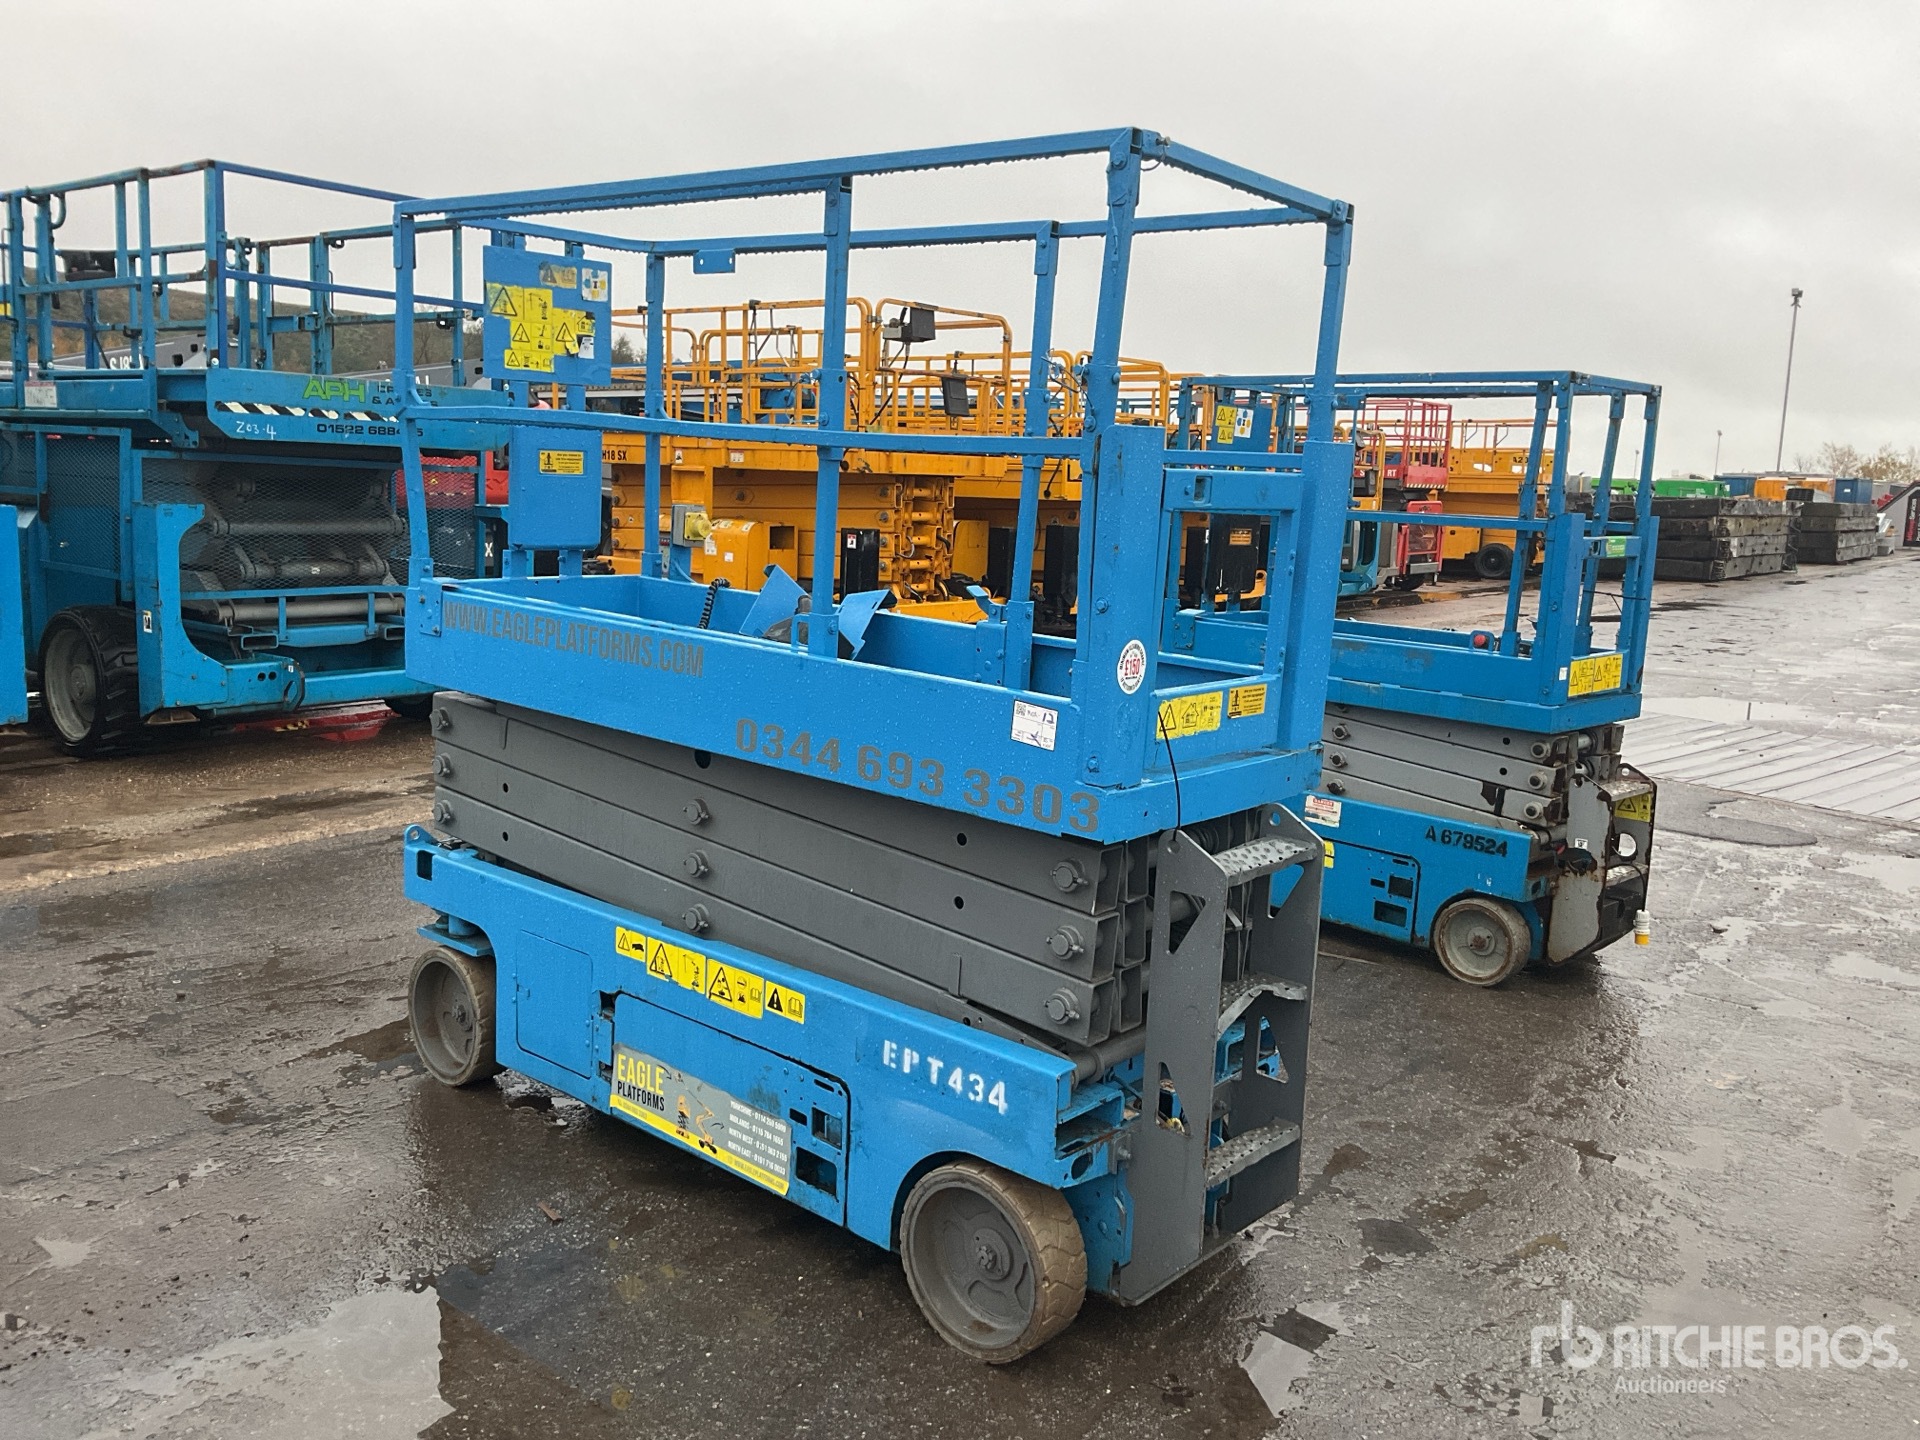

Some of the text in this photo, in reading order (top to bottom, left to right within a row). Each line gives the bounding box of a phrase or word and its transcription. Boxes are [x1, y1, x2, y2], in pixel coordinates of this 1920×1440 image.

[303, 379, 366, 403] APH
[316, 423, 424, 438] 01522 6885
[617, 449, 628, 461] SX
[443, 600, 705, 679] WWW.EAGLEPLATFORMS.COM
[1124, 657, 1140, 676] £150
[735, 719, 1100, 833] 0344 693 3303
[1425, 826, 1436, 842] A
[617, 1053, 665, 1095] EAGLE
[617, 1081, 665, 1112] PLATFORMS
